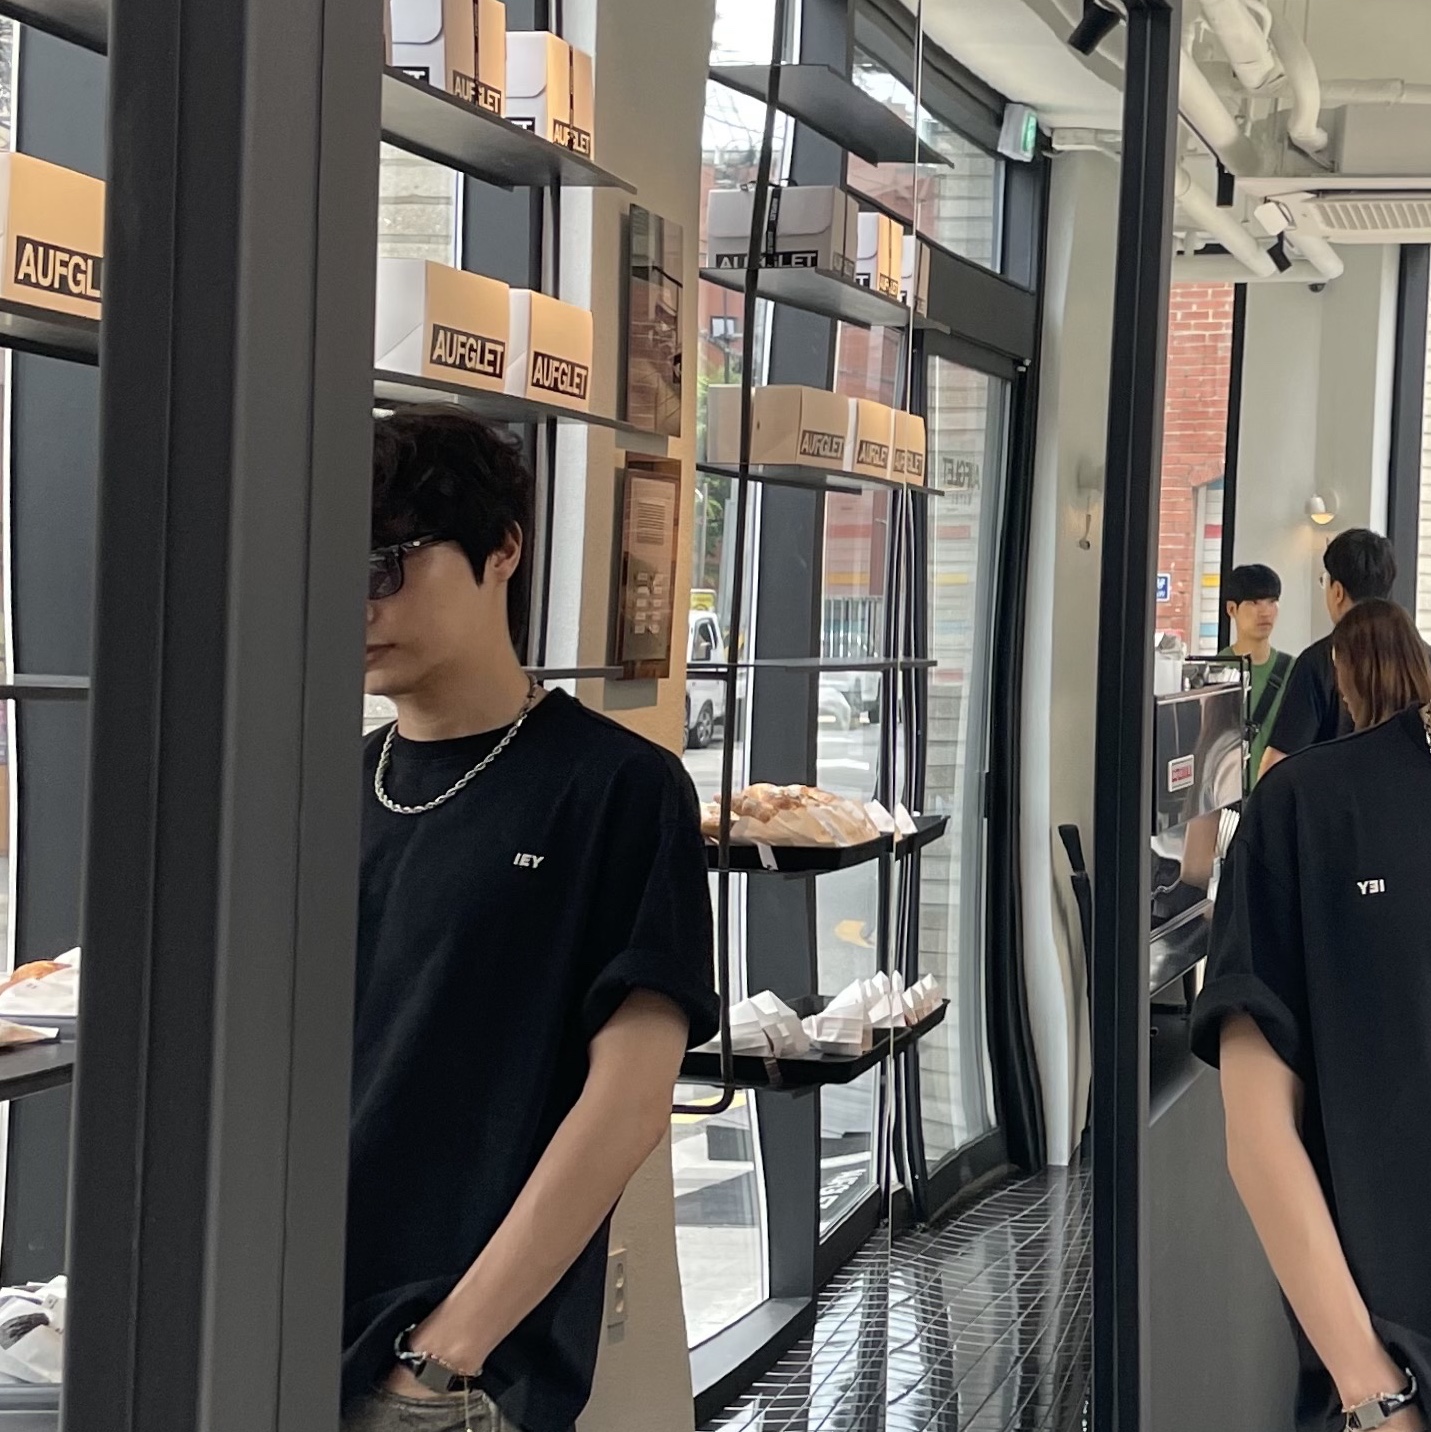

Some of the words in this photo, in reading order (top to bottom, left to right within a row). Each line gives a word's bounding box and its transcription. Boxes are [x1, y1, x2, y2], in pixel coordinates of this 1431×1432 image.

[454, 75, 500, 113] AUFLET
[17, 242, 101, 298] AUFGL
[432, 329, 505, 374] AUFGLET
[533, 356, 588, 396] AUFGLET
[802, 432, 844, 460] AUFGLET
[513, 852, 545, 868] IEY
